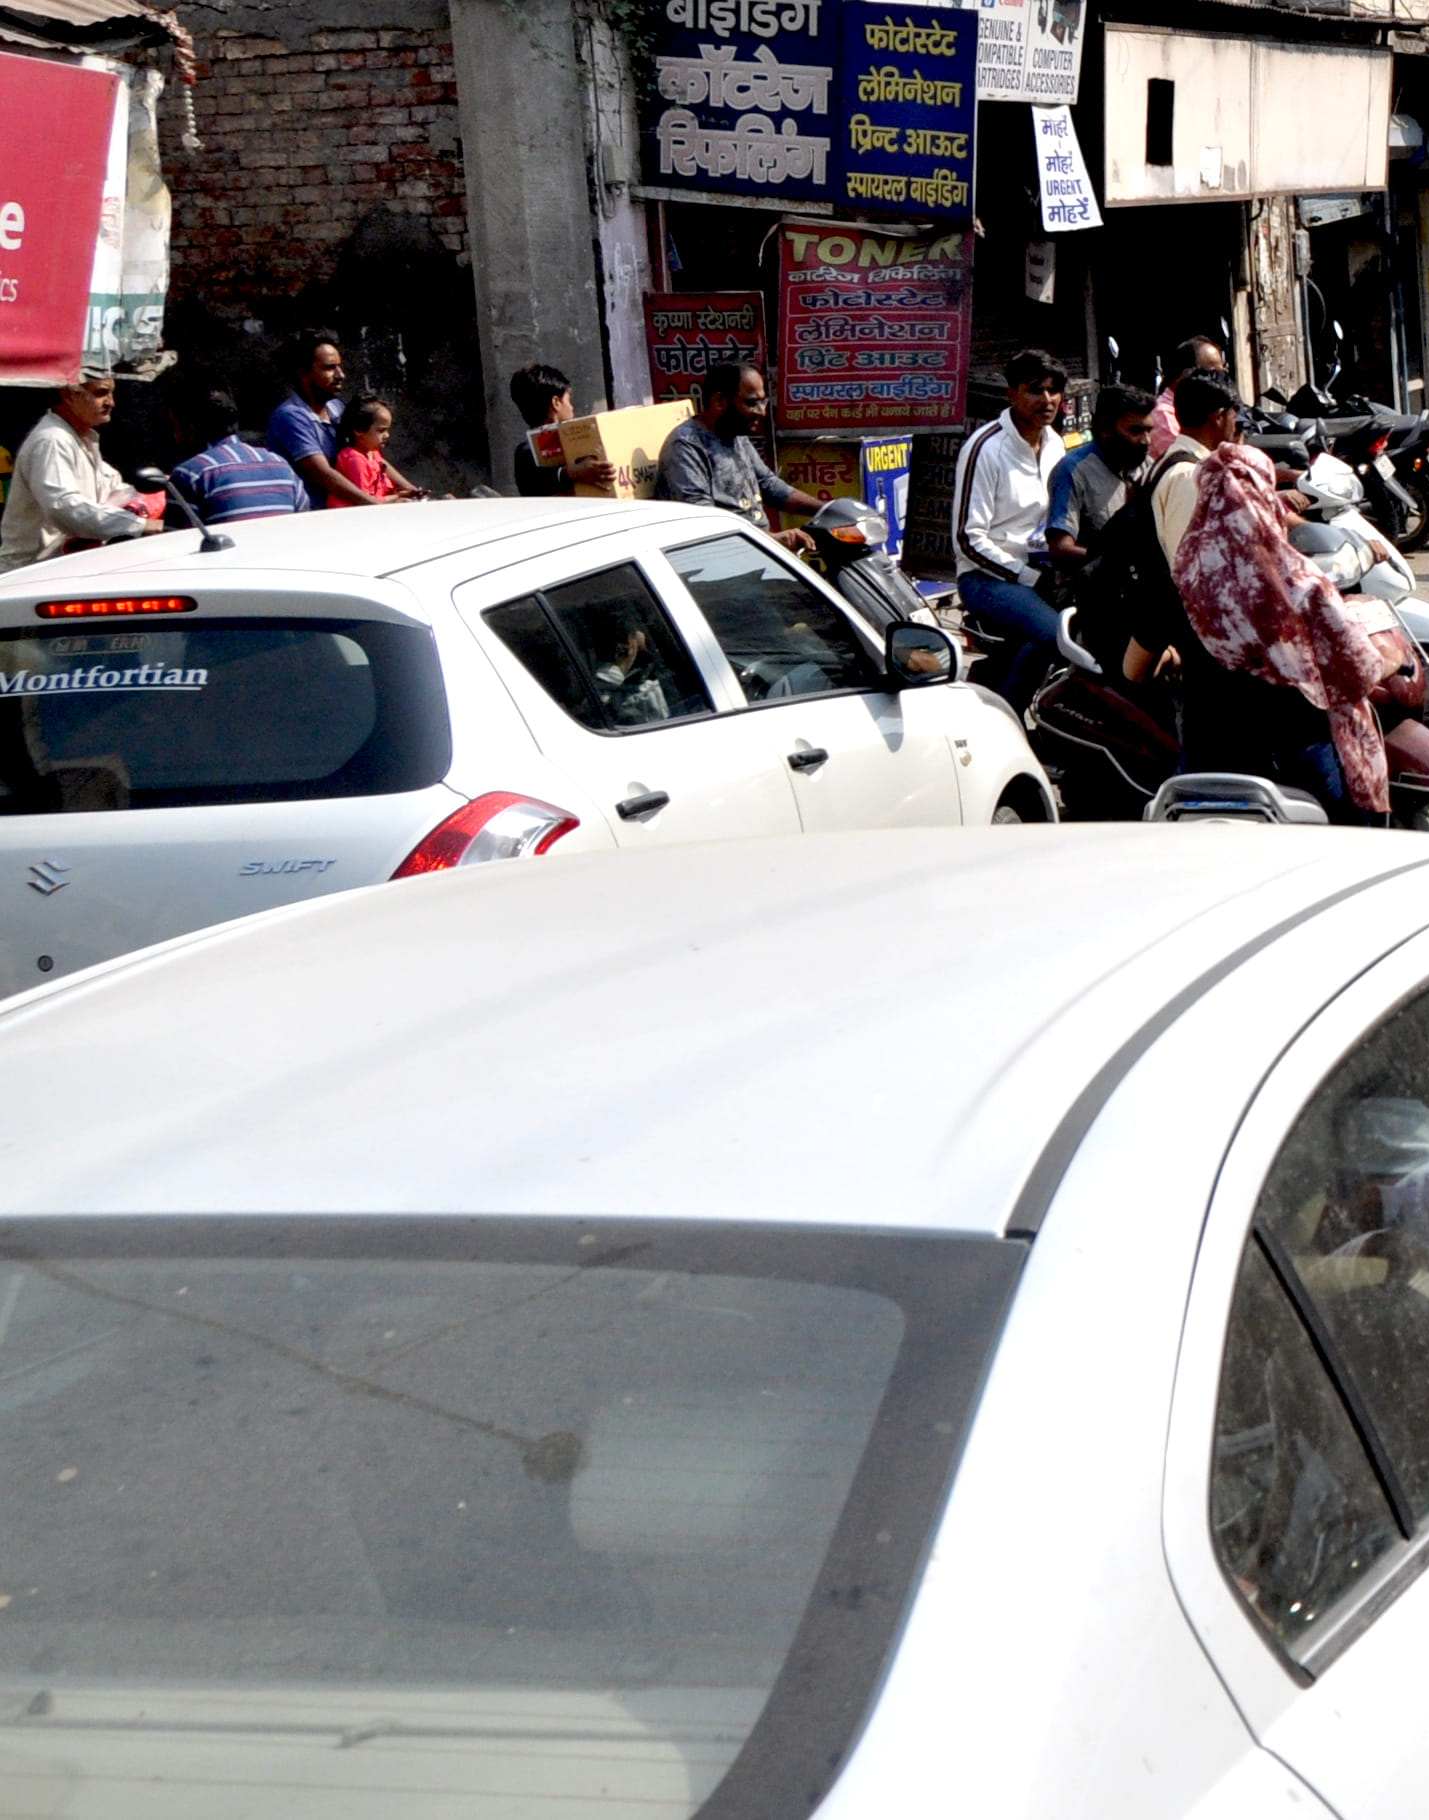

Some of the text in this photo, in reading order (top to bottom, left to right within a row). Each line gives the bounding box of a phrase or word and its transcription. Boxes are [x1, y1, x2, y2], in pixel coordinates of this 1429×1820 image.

[865, 15, 958, 56] फोटोस्टेट
[978, 42, 1024, 66] OMPATIBLE
[1032, 48, 1074, 71] COMPUTER
[857, 65, 963, 108] लेमिनेशन
[1025, 71, 1076, 95] ACCESSORIES
[1046, 179, 1082, 196] URGENT
[785, 231, 963, 268] TONER
[795, 315, 951, 344] लेमिनेशन
[865, 442, 908, 473] URGENT
[0, 662, 209, 693] Montfortian
[238, 859, 337, 875] SWIFT
